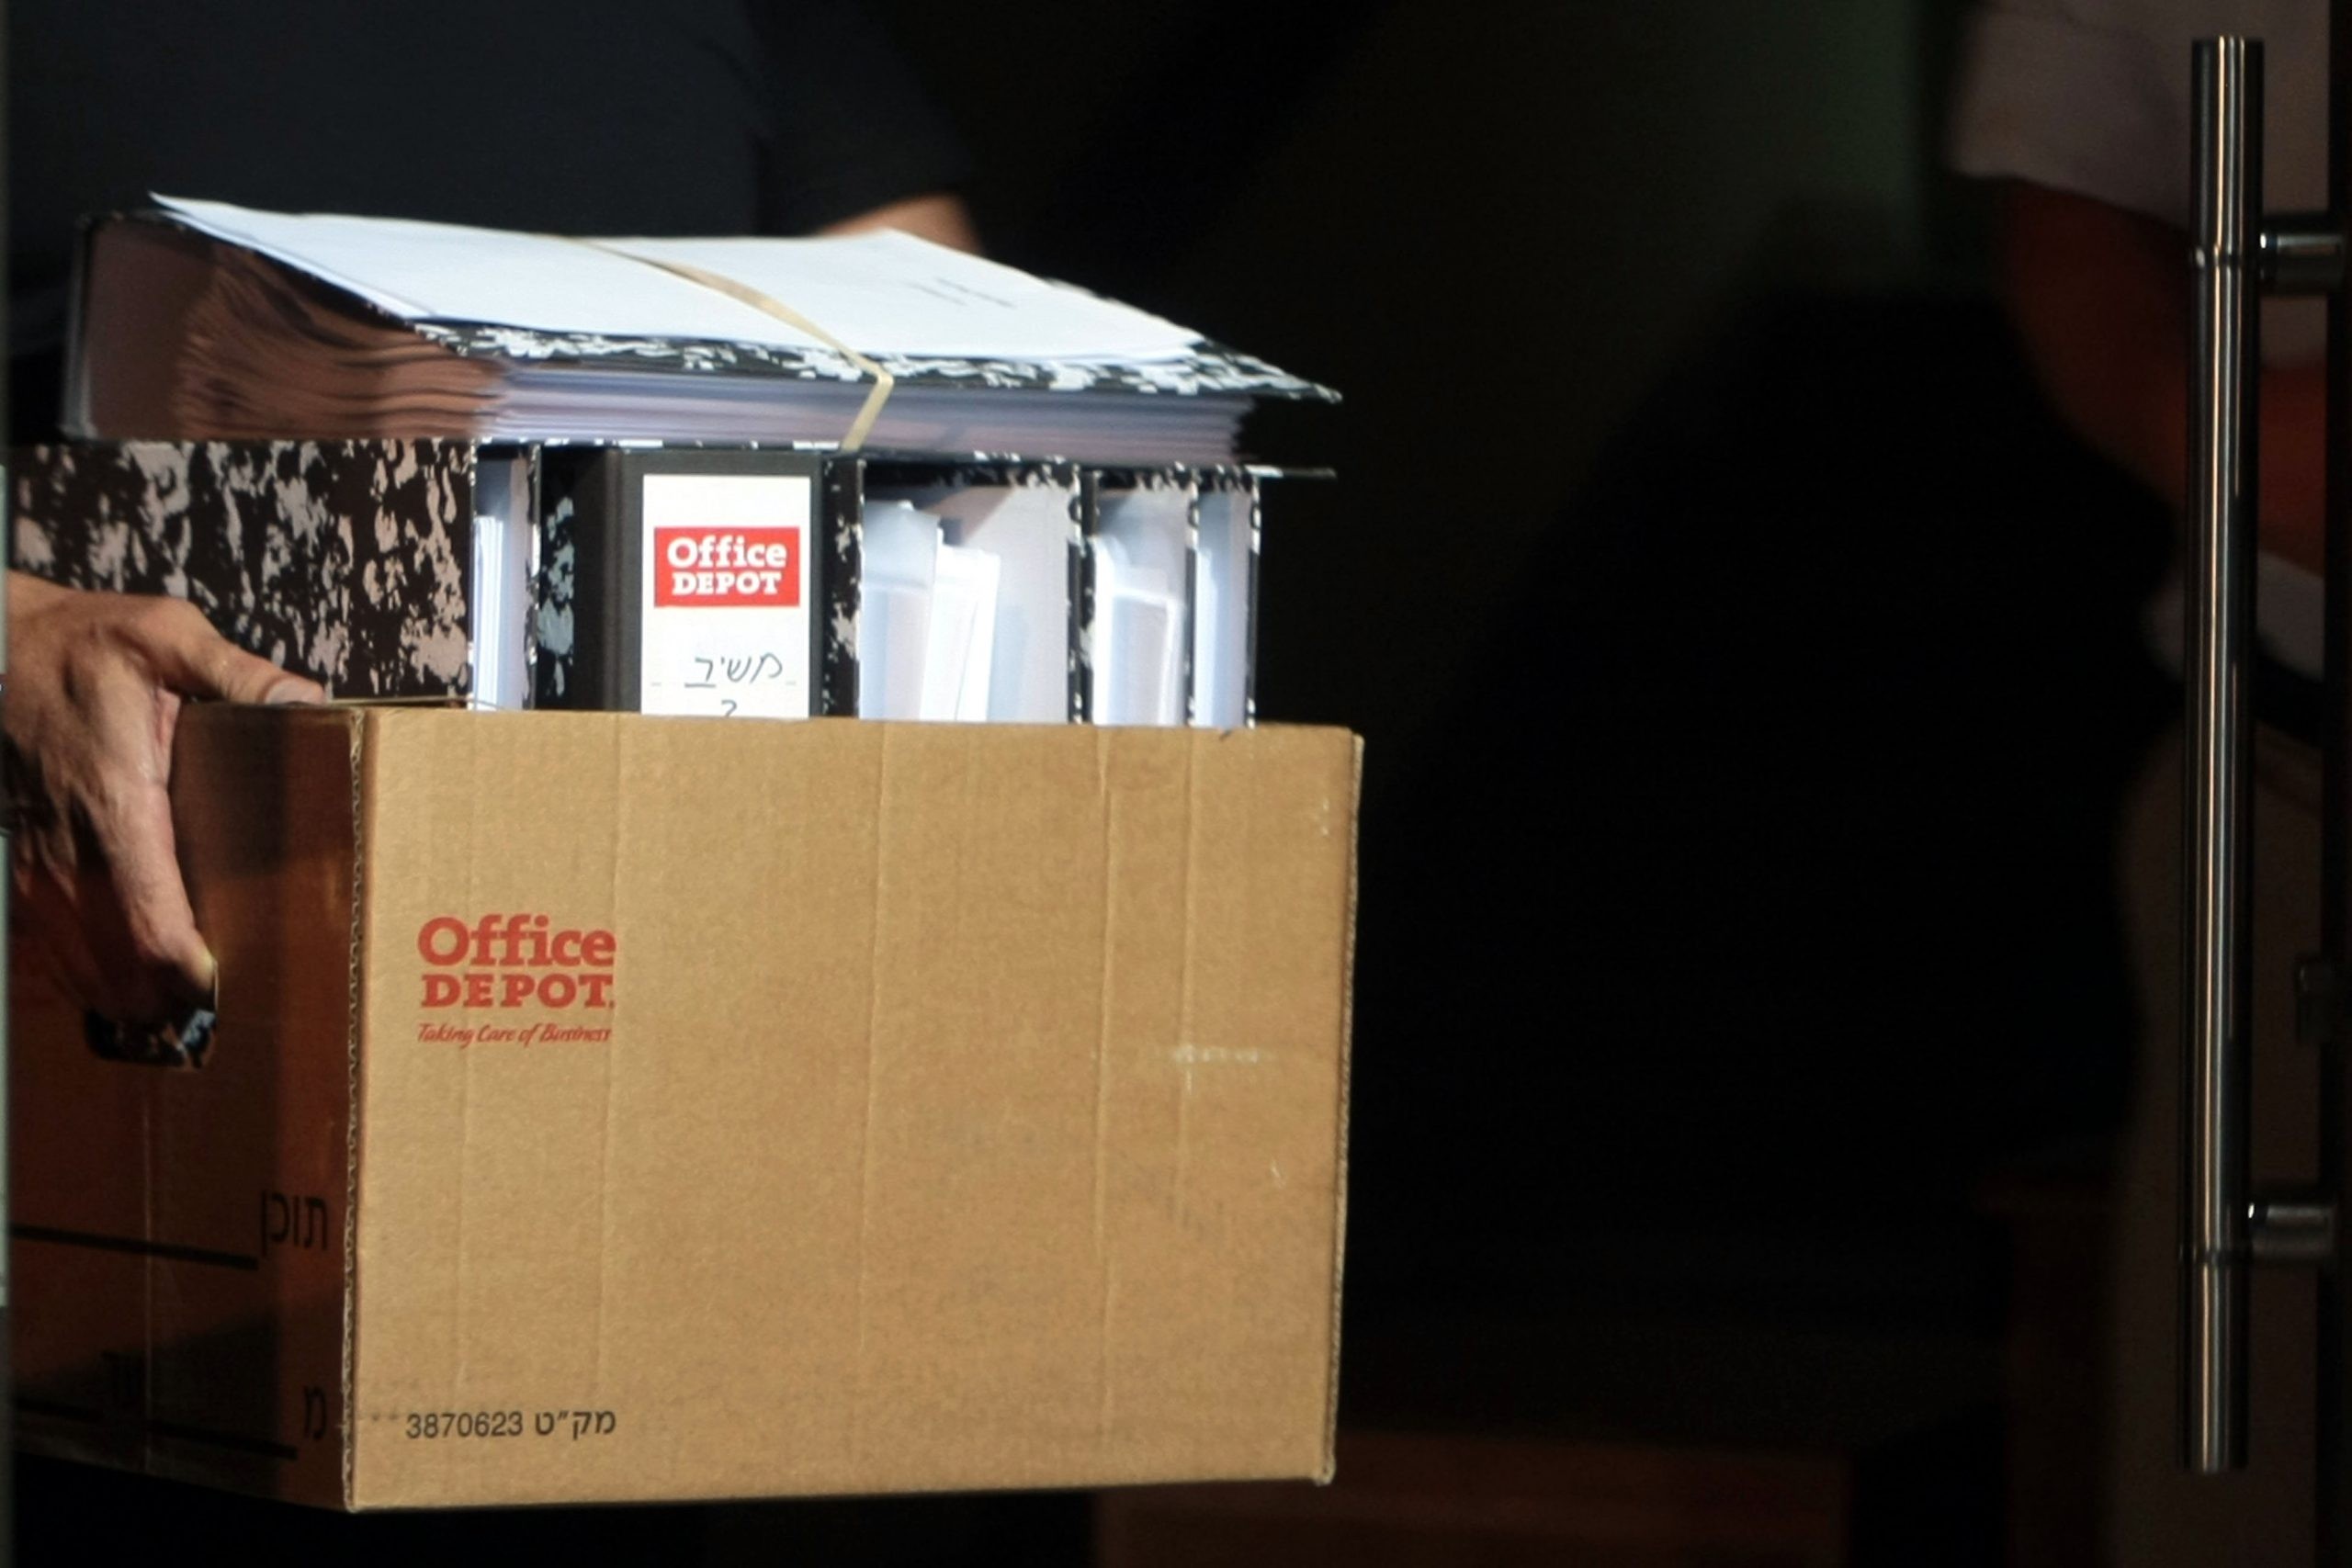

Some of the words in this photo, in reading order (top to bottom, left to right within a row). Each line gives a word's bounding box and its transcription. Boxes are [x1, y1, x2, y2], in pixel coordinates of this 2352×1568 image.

[667, 535, 787, 568] Office
[672, 571, 782, 595] DEPOT
[417, 914, 616, 966] Office
[418, 1022, 474, 1049] Taking
[477, 1024, 515, 1042] Care
[517, 1022, 541, 1047] of
[539, 1022, 611, 1043] Business
[261, 1190, 328, 1258] תוכן
[406, 1411, 524, 1438] 3870623
